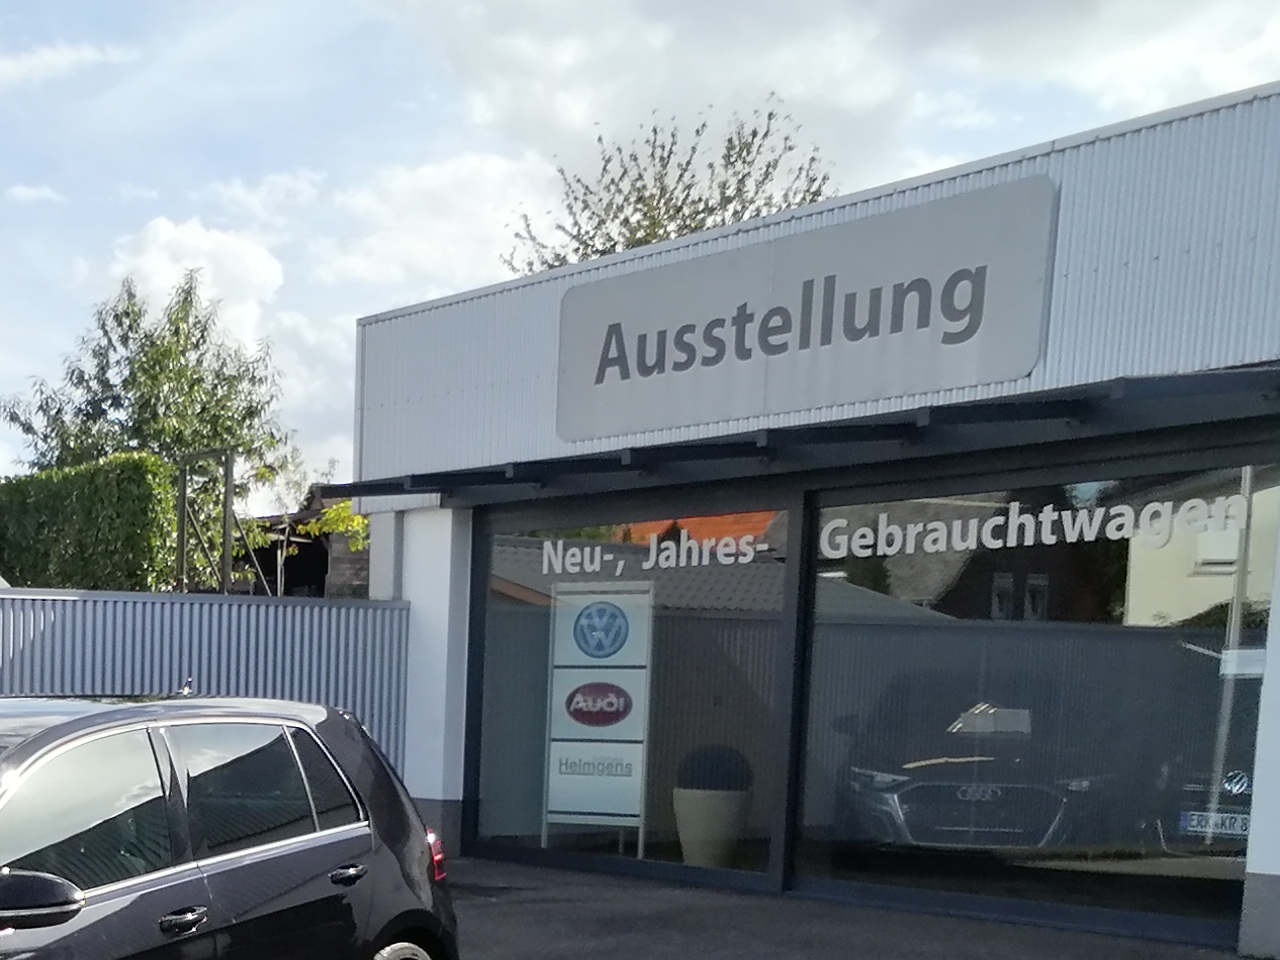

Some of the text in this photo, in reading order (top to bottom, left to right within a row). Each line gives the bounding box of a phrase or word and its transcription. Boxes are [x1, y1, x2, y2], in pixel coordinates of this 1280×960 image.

[593, 263, 988, 386] Ausstellung
[541, 494, 1247, 577] Neu-, Jahres- Gebrauchtwagen
[569, 692, 626, 713] Audi
